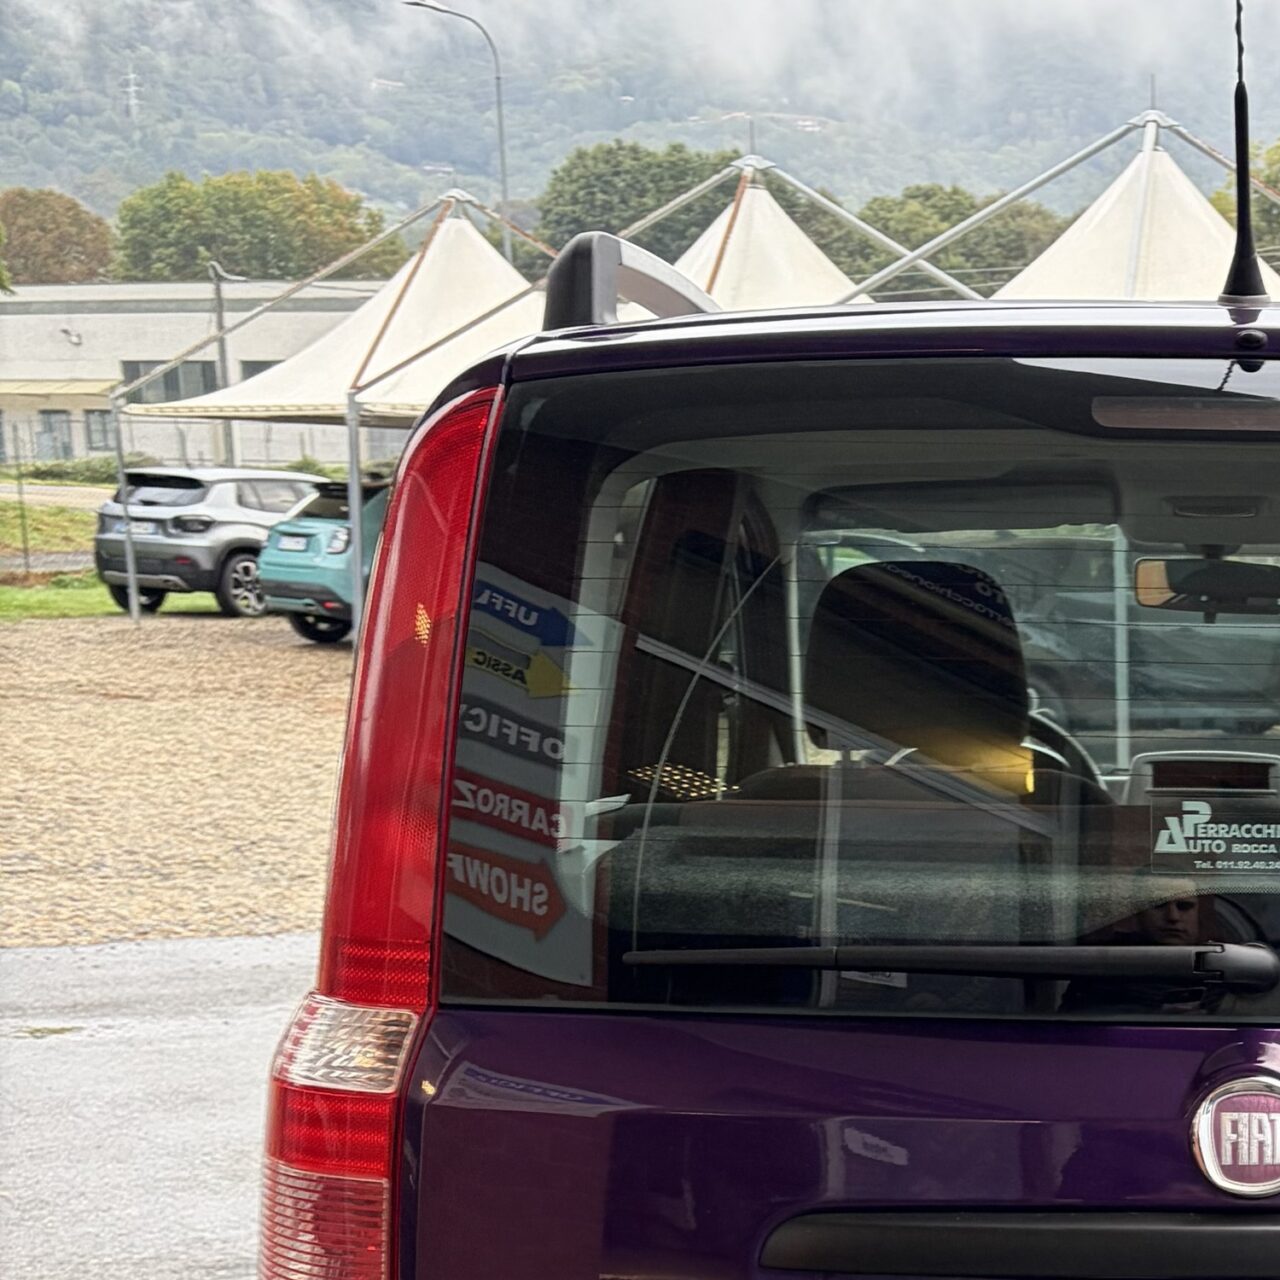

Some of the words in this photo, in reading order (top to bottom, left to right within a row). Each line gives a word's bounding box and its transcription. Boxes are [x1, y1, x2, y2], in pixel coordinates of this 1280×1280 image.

[1154, 817, 1226, 853] AUTO
[1231, 843, 1278, 854] ROCCA
[1194, 860, 1214, 870] Tel.
